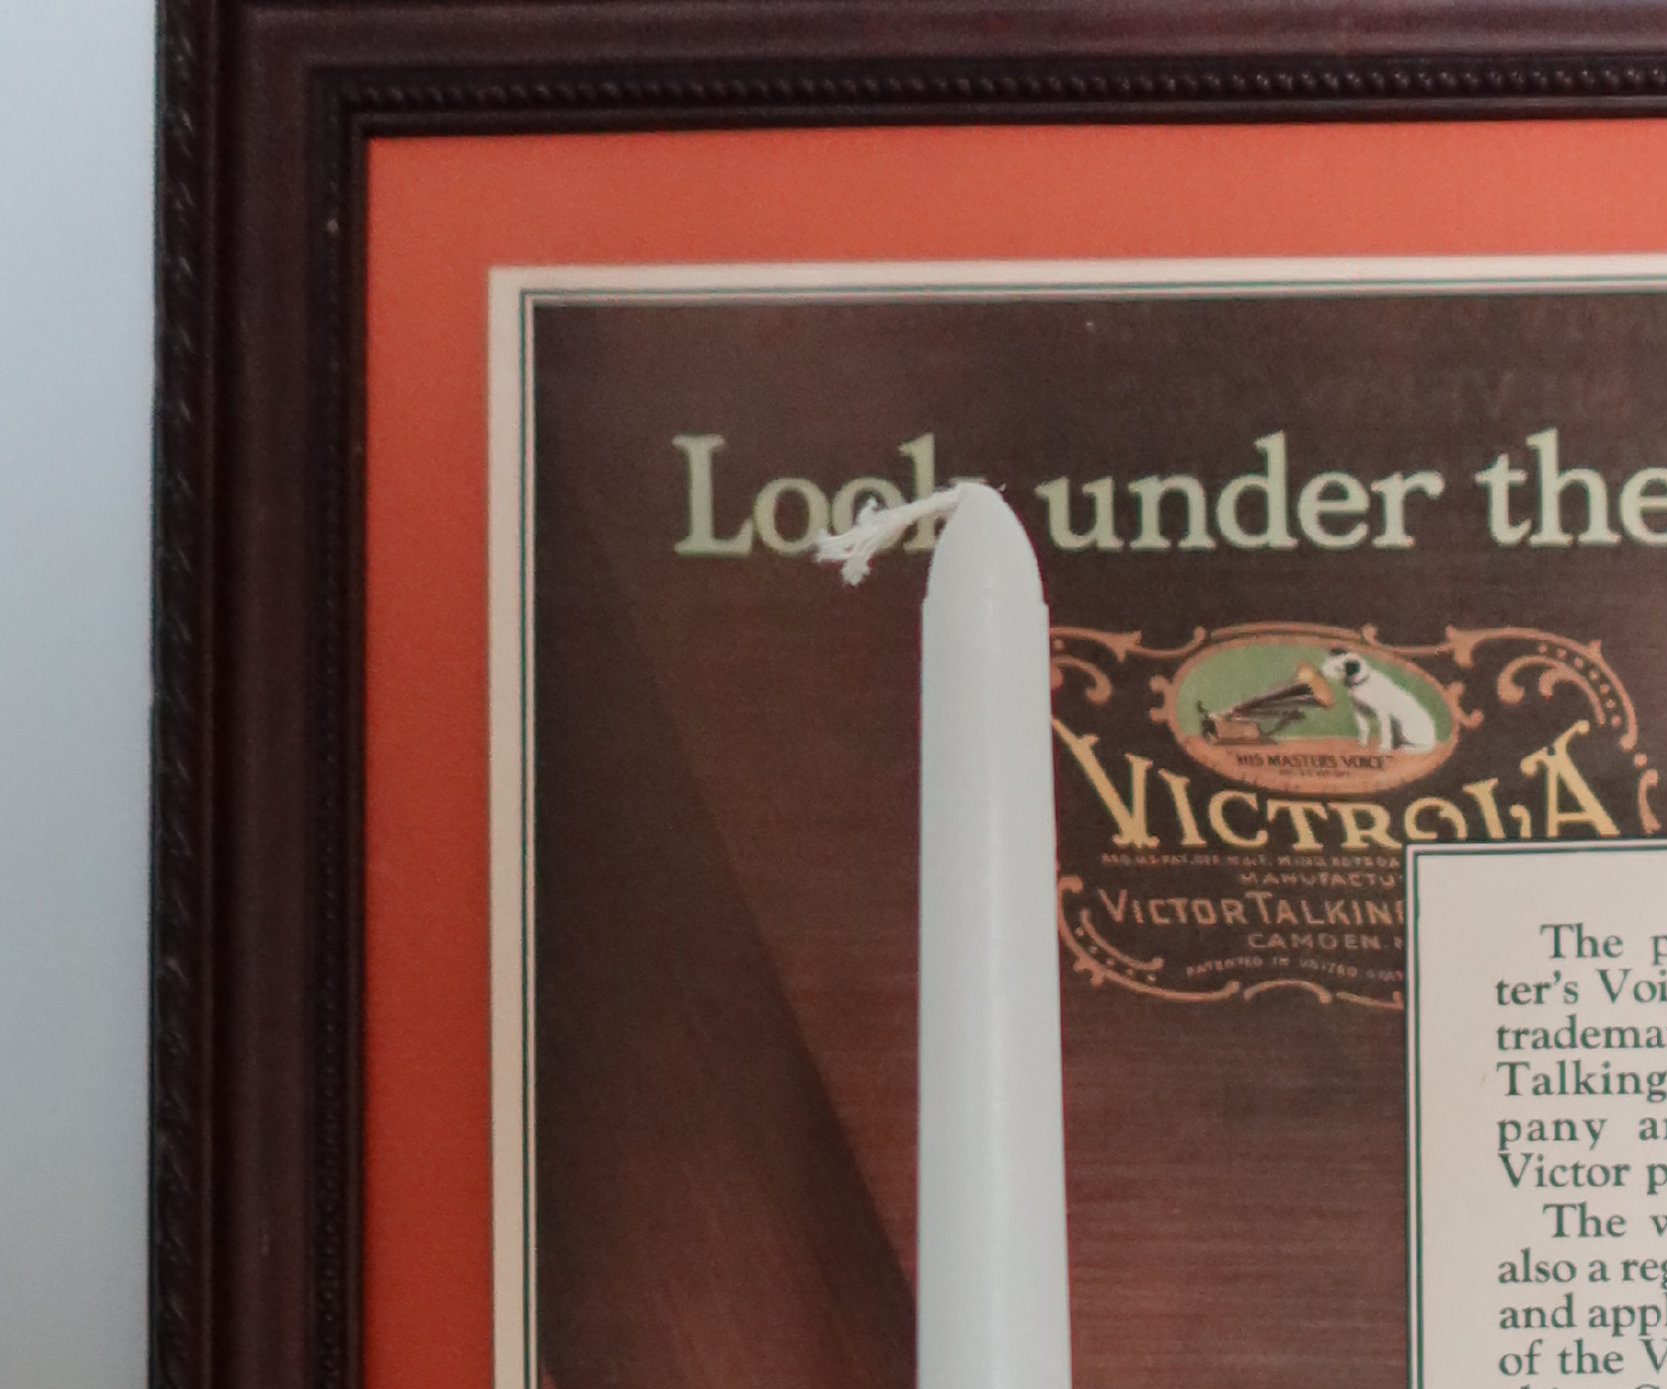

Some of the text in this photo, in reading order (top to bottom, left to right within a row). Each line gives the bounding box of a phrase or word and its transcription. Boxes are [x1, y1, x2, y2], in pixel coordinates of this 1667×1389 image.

[1036, 428, 1446, 551] under
[1099, 888, 1247, 926] VICTOR
[1539, 922, 1624, 960] The
[1496, 1118, 1608, 1152] pany
[1497, 1152, 1632, 1188] Victor
[1542, 1200, 1627, 1239] The
[1497, 1247, 1578, 1285] also
[1588, 1259, 1611, 1283] a
[1498, 1291, 1578, 1330] and
[1498, 1338, 1544, 1377] of
[1557, 1337, 1624, 1376] the
